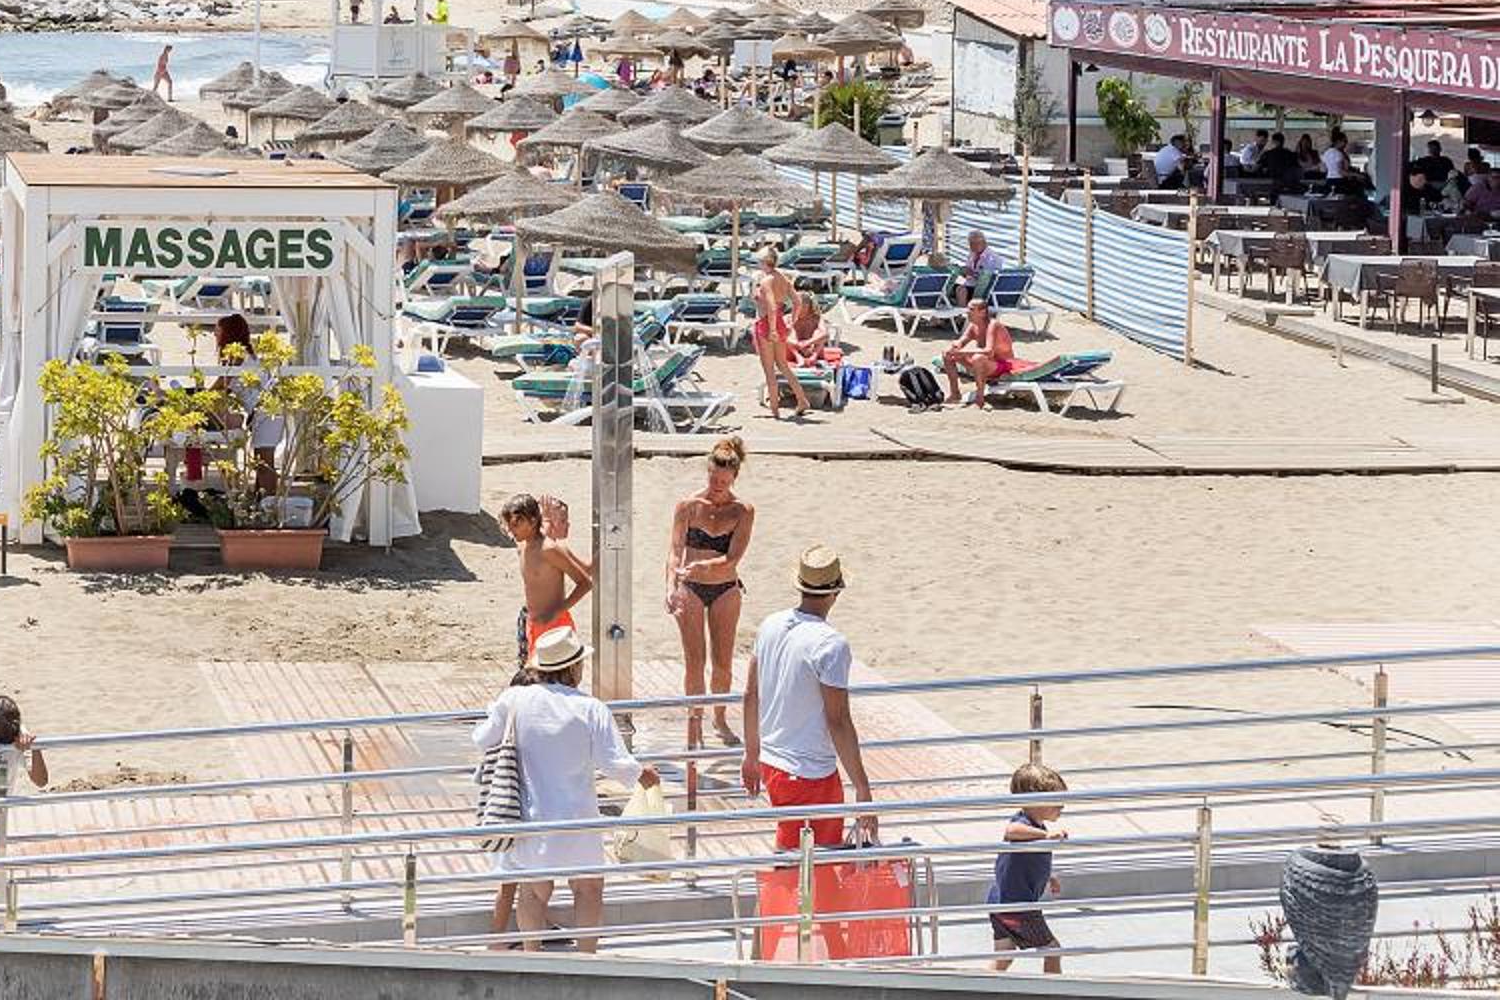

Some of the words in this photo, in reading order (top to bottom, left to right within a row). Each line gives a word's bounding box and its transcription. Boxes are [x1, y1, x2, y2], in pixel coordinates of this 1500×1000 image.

[1179, 16, 1311, 69] RESTAURANTE
[1319, 28, 1349, 73] LA
[1350, 30, 1475, 87] PESQUERA
[84, 226, 334, 270] MASSAGES
